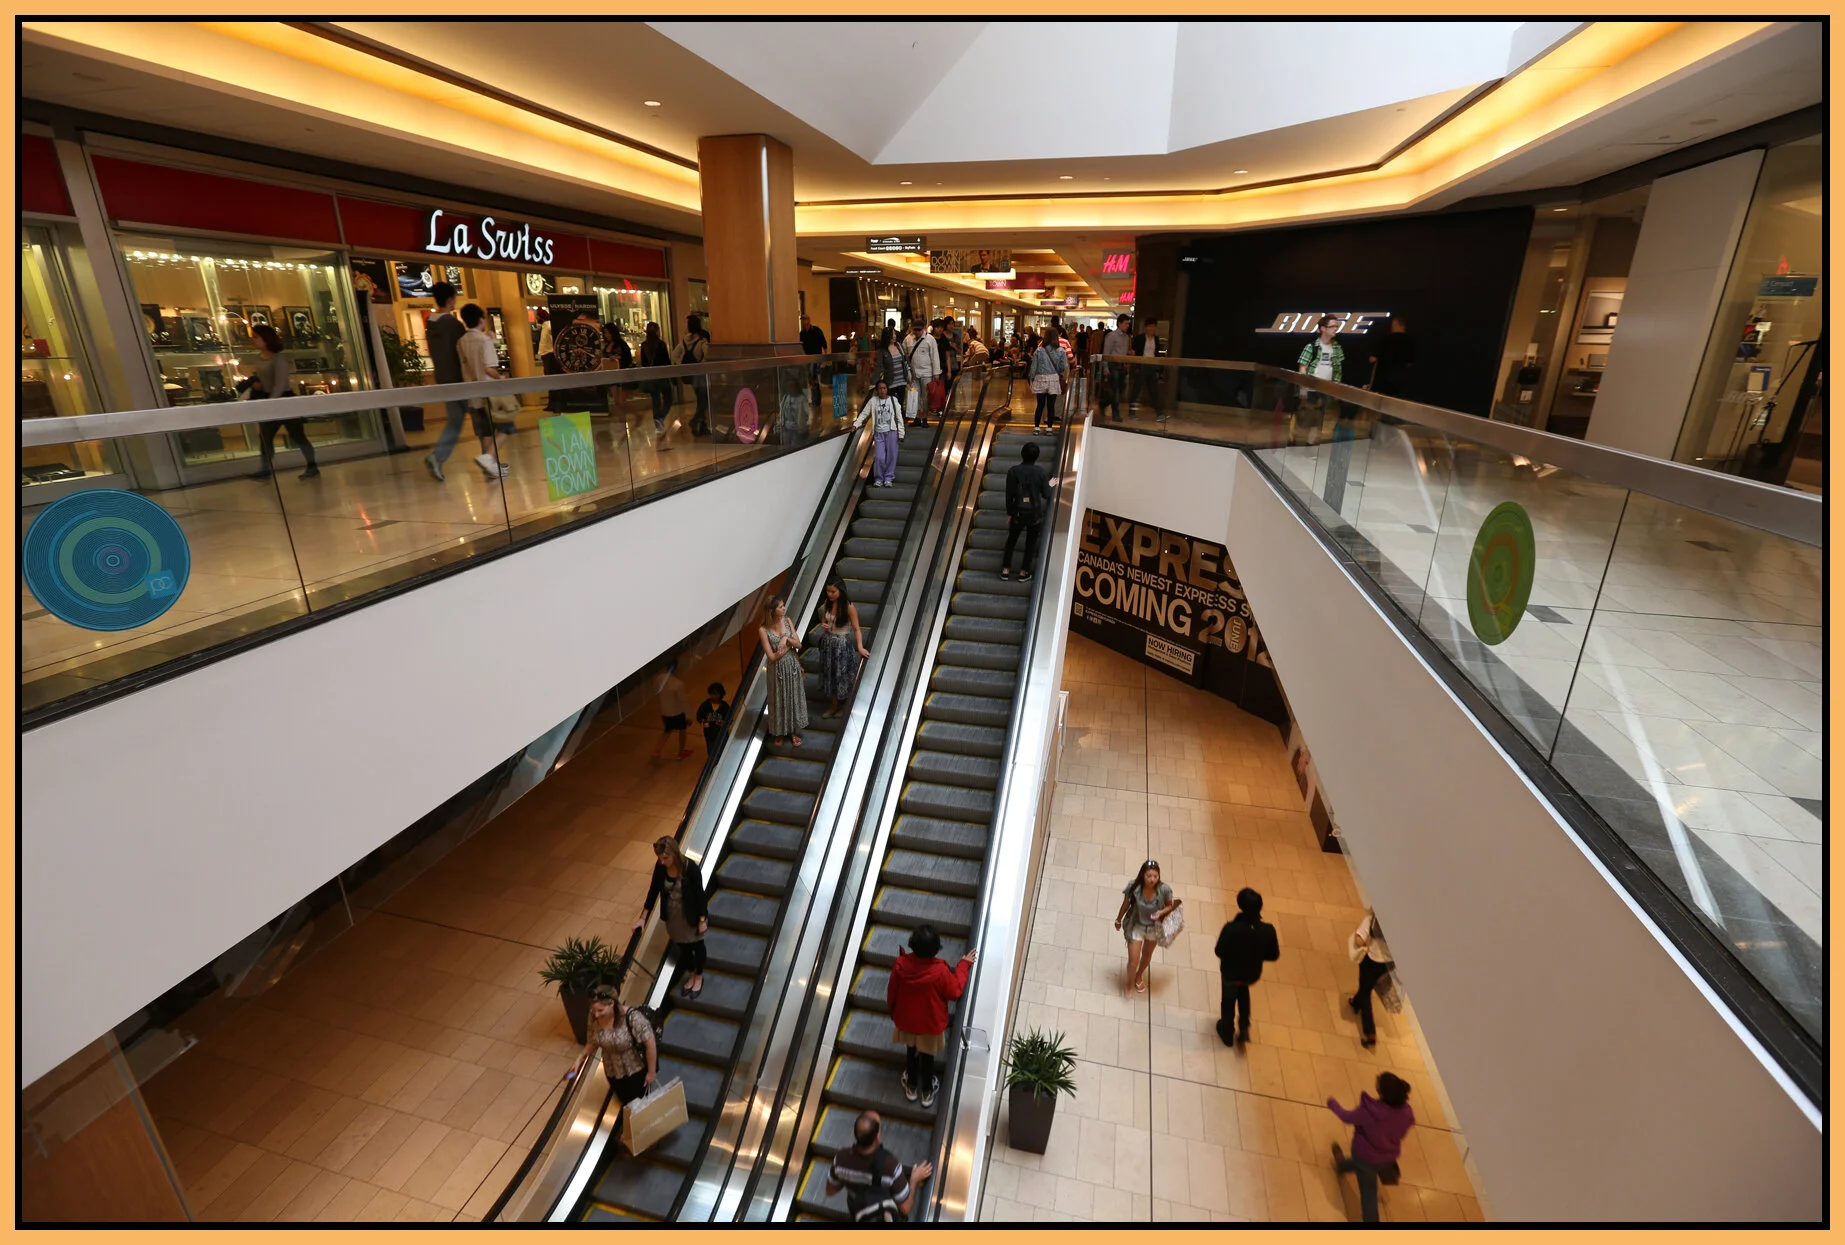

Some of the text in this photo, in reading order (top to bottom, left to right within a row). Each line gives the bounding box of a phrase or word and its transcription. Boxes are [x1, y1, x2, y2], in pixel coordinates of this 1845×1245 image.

[426, 209, 553, 264] La Swiss
[931, 255, 961, 266] DOWN
[934, 264, 961, 272] TOWN
[1103, 254, 1130, 273] H&M
[1255, 312, 1390, 334] BOSE
[546, 449, 597, 478] DOWN
[551, 470, 598, 497] TOWN
[1078, 551, 1125, 576] CANADA'S
[1127, 567, 1173, 592] NEWEST
[1174, 583, 1237, 613] EXPRESS
[1075, 565, 1193, 637] COMING
[1230, 618, 1242, 651] JUNE
[1148, 637, 1166, 651] NOW
[1166, 646, 1193, 663] HIRING
